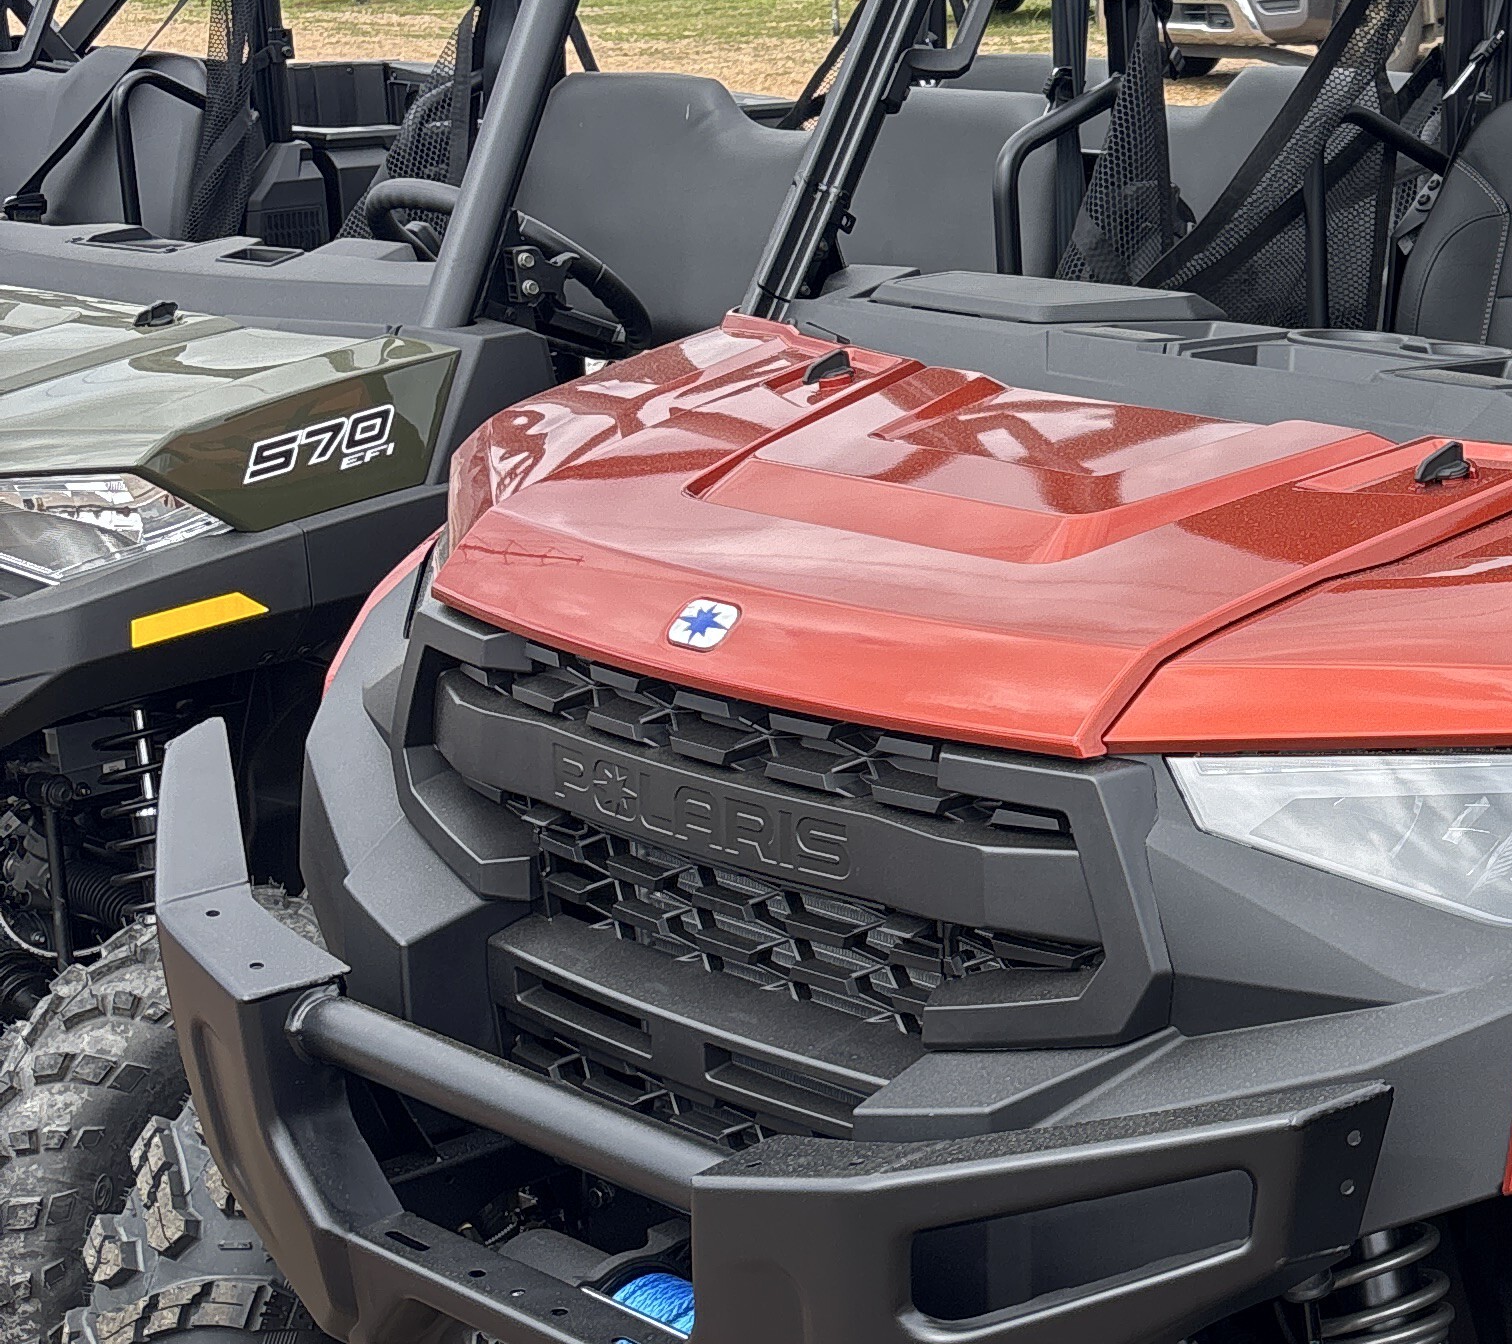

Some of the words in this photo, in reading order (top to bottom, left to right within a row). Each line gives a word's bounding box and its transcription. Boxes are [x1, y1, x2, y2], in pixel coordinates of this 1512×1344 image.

[243, 404, 395, 484] 570
[339, 442, 395, 471] EFI
[552, 742, 851, 881] POLARIS
